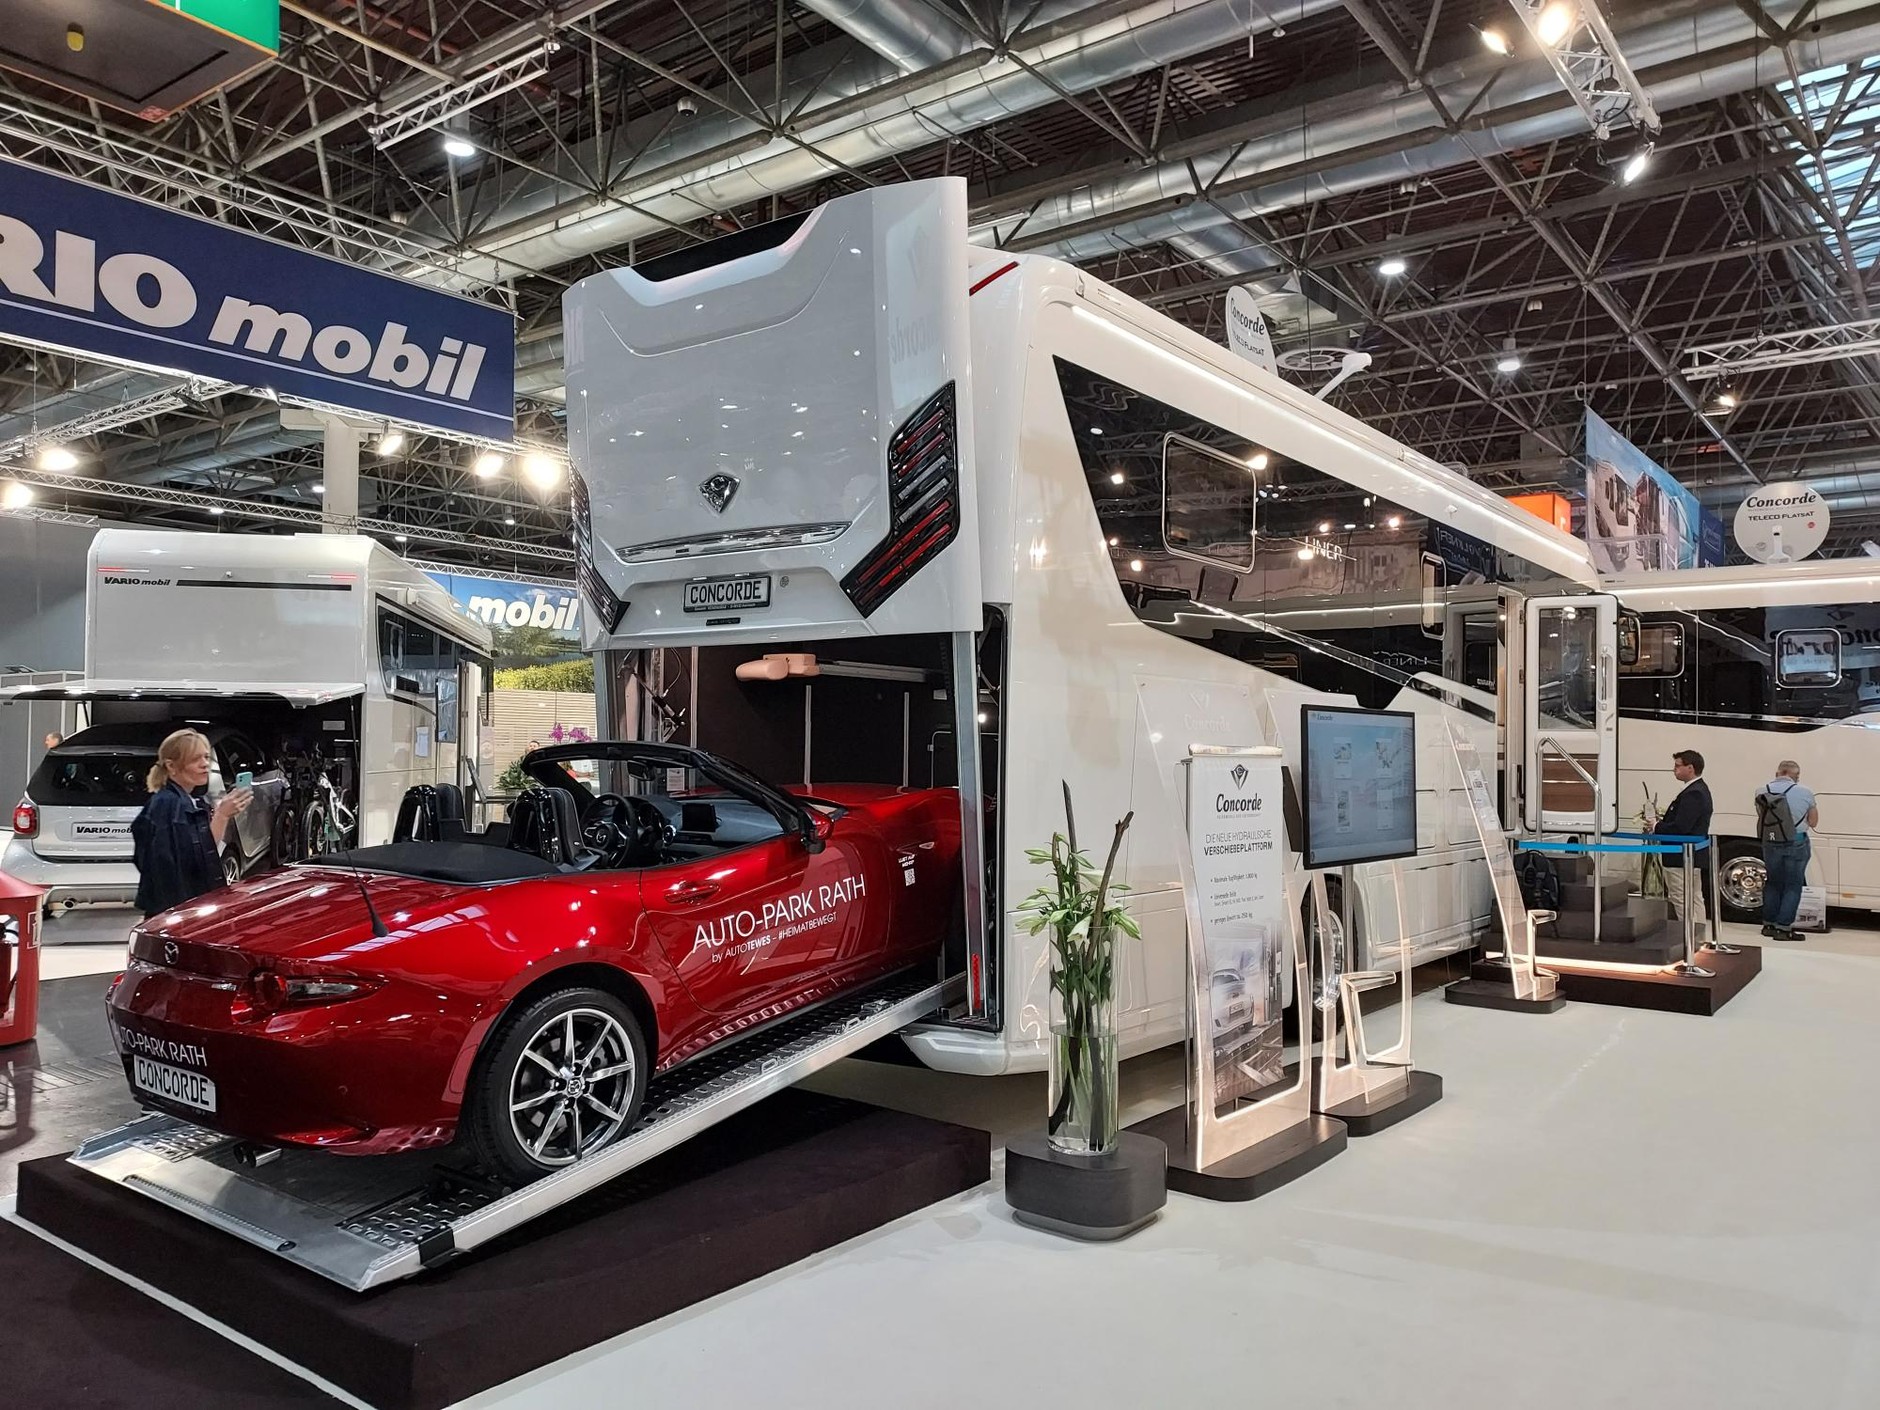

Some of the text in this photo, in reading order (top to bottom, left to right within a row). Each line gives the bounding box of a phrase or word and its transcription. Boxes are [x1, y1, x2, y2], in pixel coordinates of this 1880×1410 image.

[1230, 298, 1265, 335] Concorde
[208, 296, 486, 401] mobil
[1747, 492, 1816, 508] Concorde
[1782, 511, 1815, 519] FLATSAT
[104, 576, 140, 585] VARIO
[690, 580, 762, 604] CONCORDE
[1216, 792, 1262, 812] Concorde
[692, 873, 867, 954] AUTO-PARK RATH
[711, 951, 723, 963] by
[725, 934, 771, 957] AUTOTEWES
[778, 911, 837, 941] #HEIMATBEWEGT
[169, 1042, 208, 1067] RATH
[138, 1059, 210, 1106] CONCORDE
